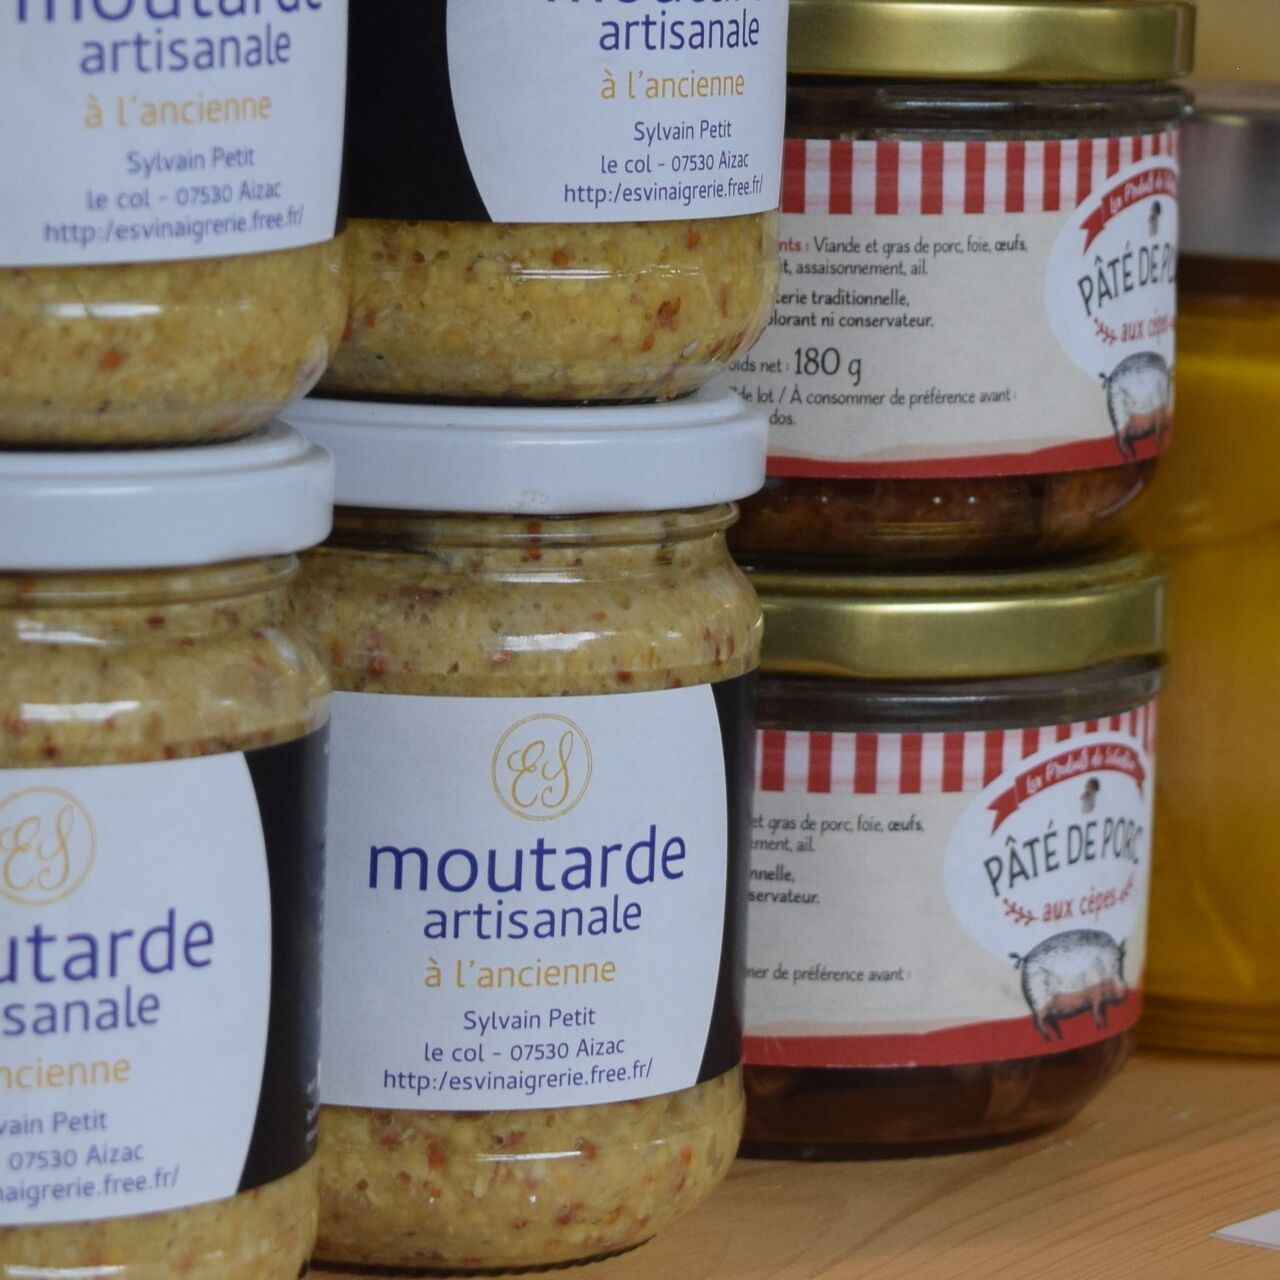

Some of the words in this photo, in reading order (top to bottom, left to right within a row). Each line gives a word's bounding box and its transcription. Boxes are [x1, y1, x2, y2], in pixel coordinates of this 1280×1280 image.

[598, 8, 760, 51] artisanale
[80, 23, 292, 75] artisanale
[600, 68, 616, 100] à
[84, 94, 104, 129] à
[633, 121, 694, 146] Sylvain
[699, 119, 733, 138] Petit
[126, 149, 206, 179] Sylvain
[212, 146, 256, 168] Petit
[600, 154, 618, 174] le
[624, 154, 652, 174] col
[671, 154, 714, 172] 07530
[718, 149, 749, 169] Aizac
[87, 190, 108, 211] le
[116, 188, 150, 210] col
[176, 185, 233, 207] 07530
[238, 179, 282, 201] Aizac
[813, 236, 861, 254] Viande
[865, 236, 878, 253] et
[882, 240, 911, 259] gras
[914, 236, 930, 254] de
[933, 240, 964, 259] porc,
[967, 234, 992, 255] foie,
[994, 233, 1029, 254] œufs,
[796, 259, 909, 278] assaisonnement,
[911, 258, 928, 276] ail.
[1077, 242, 1134, 317] PÂTÉ
[1138, 246, 1159, 287] DE
[812, 288, 911, 308] traditionnelle,
[821, 312, 835, 327] ni
[839, 312, 935, 329] conservateur.
[760, 357, 783, 373] net
[794, 347, 841, 376] 180
[848, 358, 862, 387] g
[757, 385, 774, 403] lot
[790, 384, 802, 404] À
[806, 392, 886, 405] consommer
[889, 388, 906, 407] de
[909, 387, 977, 410] préférence
[979, 388, 1011, 404] avant
[769, 407, 796, 426] dos.
[768, 817, 796, 835] gras
[800, 813, 817, 831] de
[821, 820, 854, 836] porc,
[856, 814, 885, 833] foie,
[888, 815, 924, 834] œufs,
[368, 824, 686, 894] moutarde
[796, 836, 815, 852] ail.
[984, 822, 1060, 897] PÂTÉ
[1067, 824, 1099, 866] DE
[1101, 816, 1144, 865] PORC
[423, 894, 642, 940] artisanale
[1042, 897, 1074, 923] aux
[1078, 888, 1118, 921] cèpes
[424, 957, 442, 988] à
[455, 959, 617, 989] l'ancienne
[773, 962, 789, 980] de
[793, 963, 864, 985] préférence
[867, 966, 904, 982] avant
[463, 1009, 541, 1037] Sylvain
[549, 1007, 596, 1027] Petit
[424, 1042, 444, 1062] le
[451, 1042, 485, 1062] col
[510, 1041, 570, 1062] 07530
[576, 1037, 625, 1058] Aizac
[383, 1058, 653, 1096] http:/esvinaigrerie.free.fr/
[52, 1111, 108, 1134] Petit
[9, 1148, 78, 1170] 07530
[86, 1142, 145, 1166] Aizac
